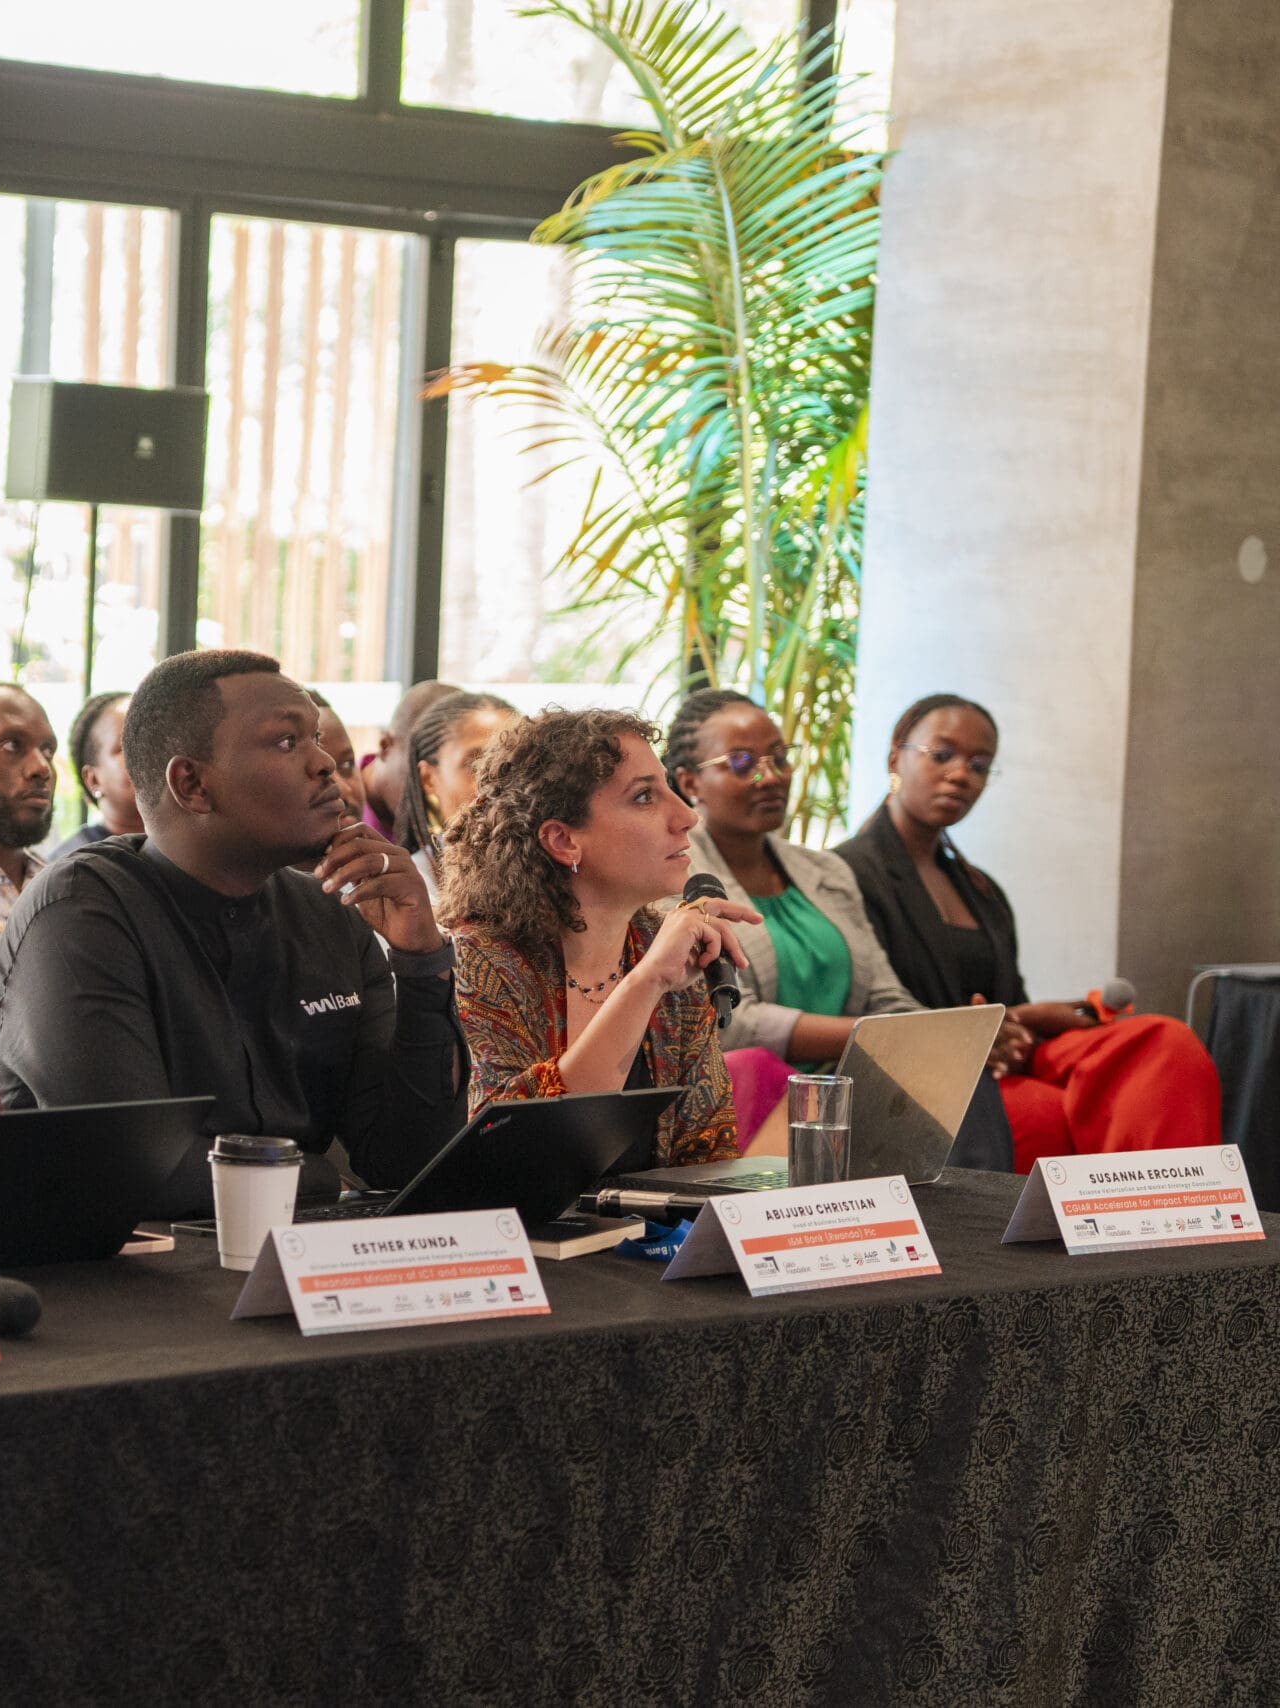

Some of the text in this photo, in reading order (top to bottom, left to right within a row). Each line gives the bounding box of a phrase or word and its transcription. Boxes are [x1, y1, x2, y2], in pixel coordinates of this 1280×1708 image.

[1089, 1166, 1205, 1184] SUSANNA ERCOLANI
[765, 1198, 876, 1221] ABIJURU CHRISTIAN
[1065, 1203, 1091, 1214] CGIAR
[1093, 1198, 1138, 1211] Accelerate
[1139, 1196, 1151, 1207] for
[1153, 1194, 1182, 1208] Impact
[1183, 1191, 1217, 1204] Platform
[352, 1235, 458, 1255] ESTHER KUNDA
[804, 1233, 823, 1246] Bank
[824, 1228, 863, 1243] (Rwanda)
[363, 1273, 403, 1286] Ministry
[437, 1265, 458, 1277] and
